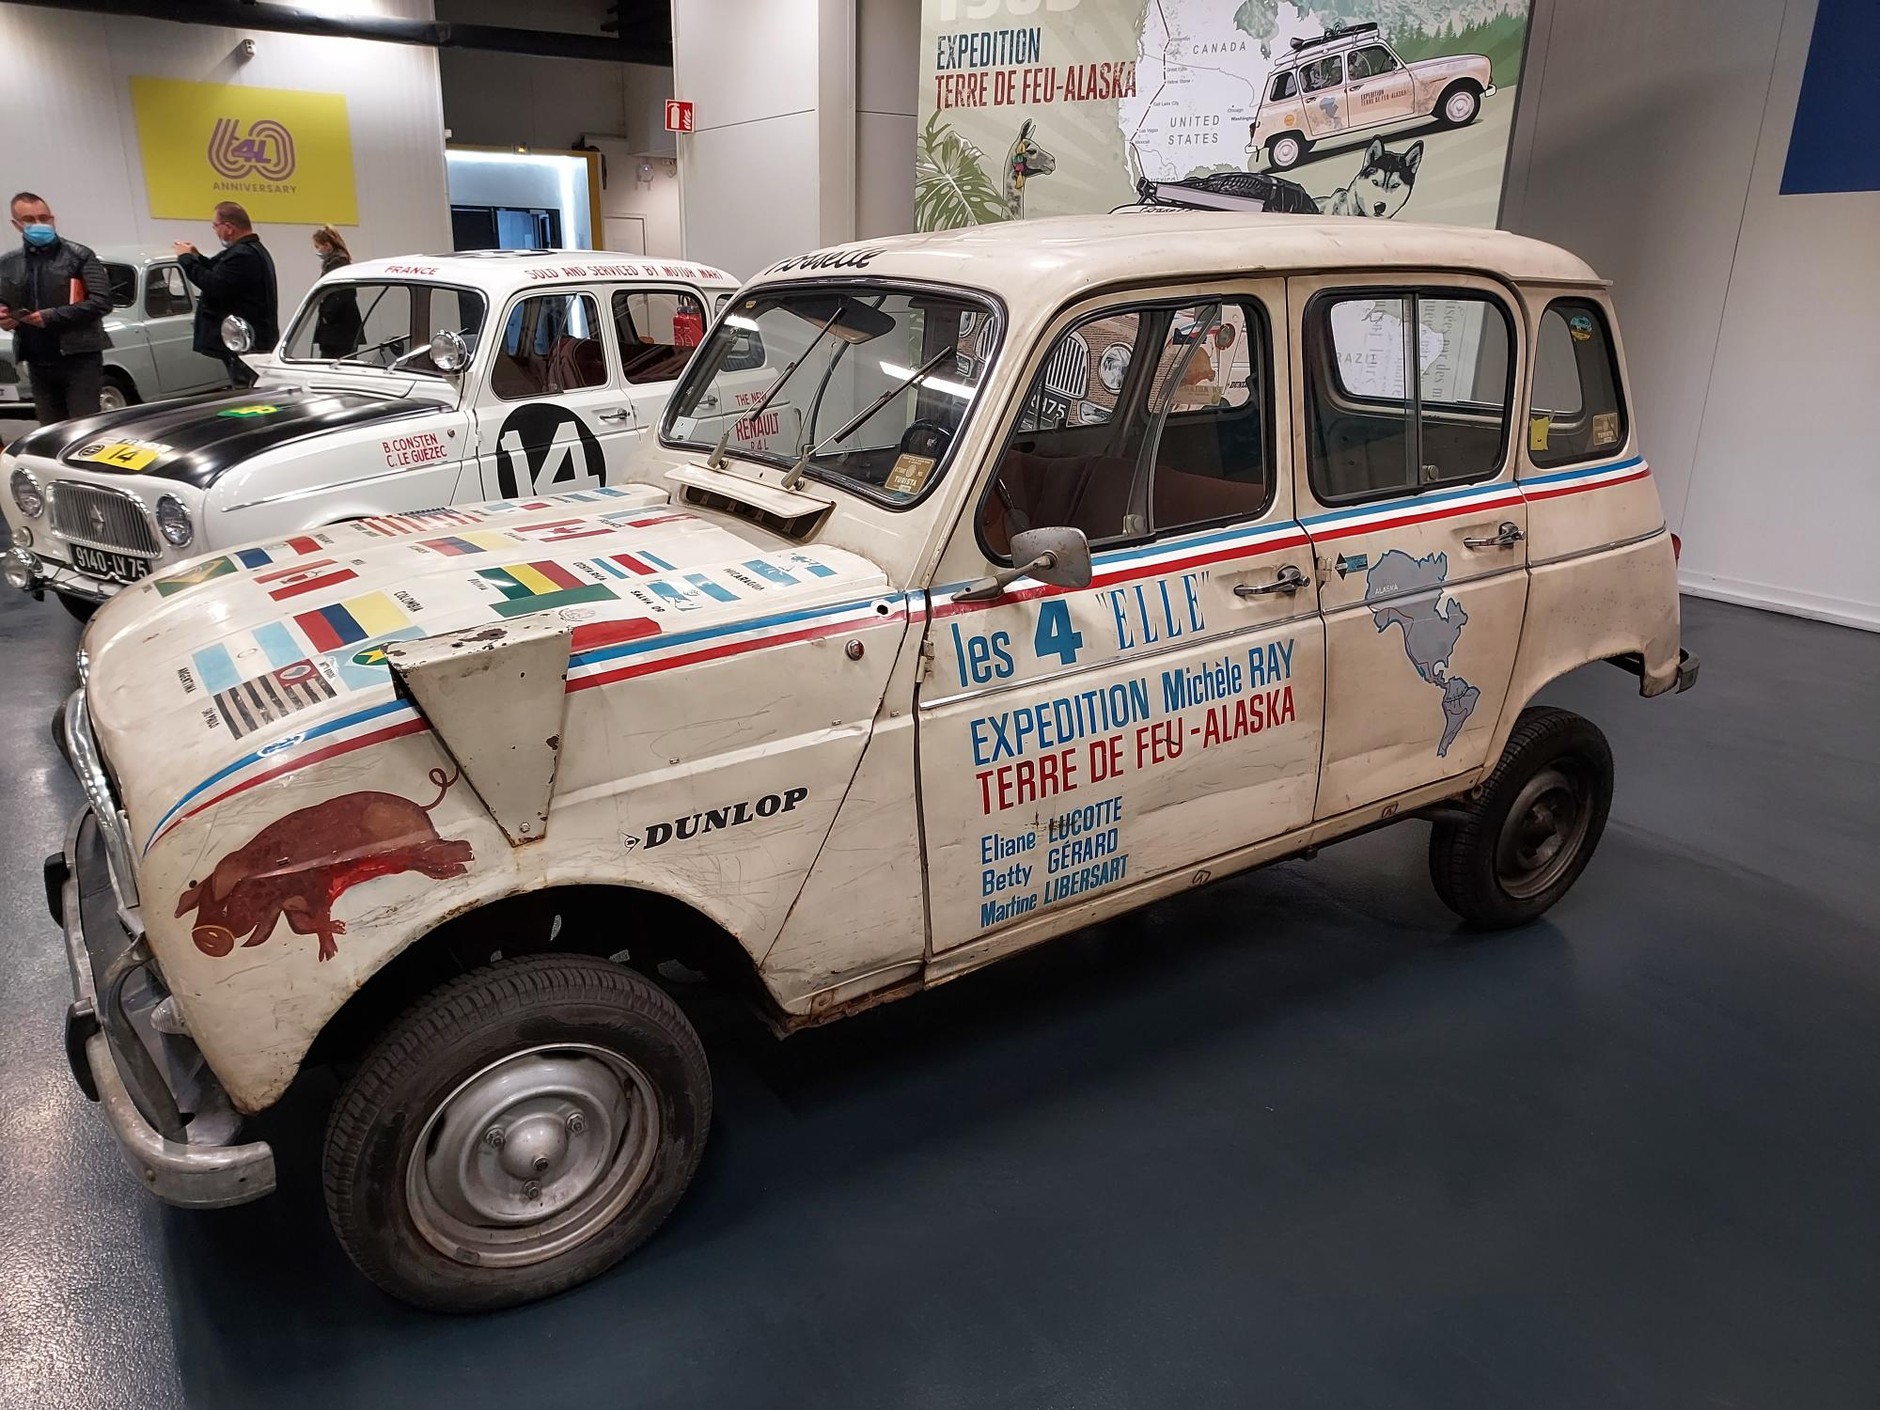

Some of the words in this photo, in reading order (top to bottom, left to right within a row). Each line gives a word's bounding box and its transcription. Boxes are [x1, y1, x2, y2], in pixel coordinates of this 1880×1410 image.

[936, 27, 1041, 70] EXPEDITION
[1193, 41, 1246, 54] CANADA
[935, 71, 989, 109] TERRE
[994, 70, 1017, 105] DE
[1022, 61, 1137, 104] FEU-ALASKA
[1170, 115, 1220, 128] UNITED
[231, 138, 272, 164] 4L
[1168, 133, 1219, 146] STATES
[213, 182, 297, 193] ANNIVERSARY
[384, 265, 440, 276] FRANCE
[524, 267, 559, 280] SOLD
[561, 266, 587, 277] AND
[587, 265, 639, 276] SERVICED
[642, 265, 659, 276] BY
[660, 265, 697, 278] MOTOR
[697, 268, 724, 280] MART
[735, 394, 750, 406] THE
[750, 391, 767, 404] NEW
[735, 412, 779, 441] RENAULT
[107, 446, 139, 463] 14
[397, 452, 410, 465] LE
[411, 445, 447, 462] GUEZEC
[500, 420, 601, 498] 14
[130, 558, 148, 578] 75
[1375, 583, 1399, 595] ALASKA
[951, 622, 1015, 688] les
[1034, 599, 1084, 666] 4
[1095, 570, 1211, 651] "ELLE"
[970, 678, 1150, 767] EXPEDITION
[1162, 656, 1242, 713] Michèle
[1248, 639, 1294, 689] RAY
[976, 748, 1077, 815] TERRE
[1089, 735, 1124, 784] DE
[643, 787, 809, 850] DUNLOP
[981, 830, 1036, 865] Eliane
[1049, 796, 1123, 844] LUCOTTE
[981, 863, 1033, 897] Betty
[1047, 828, 1118, 874] GÉRARD
[980, 893, 1037, 929] Martine
[1043, 853, 1129, 905] LIBERSART
